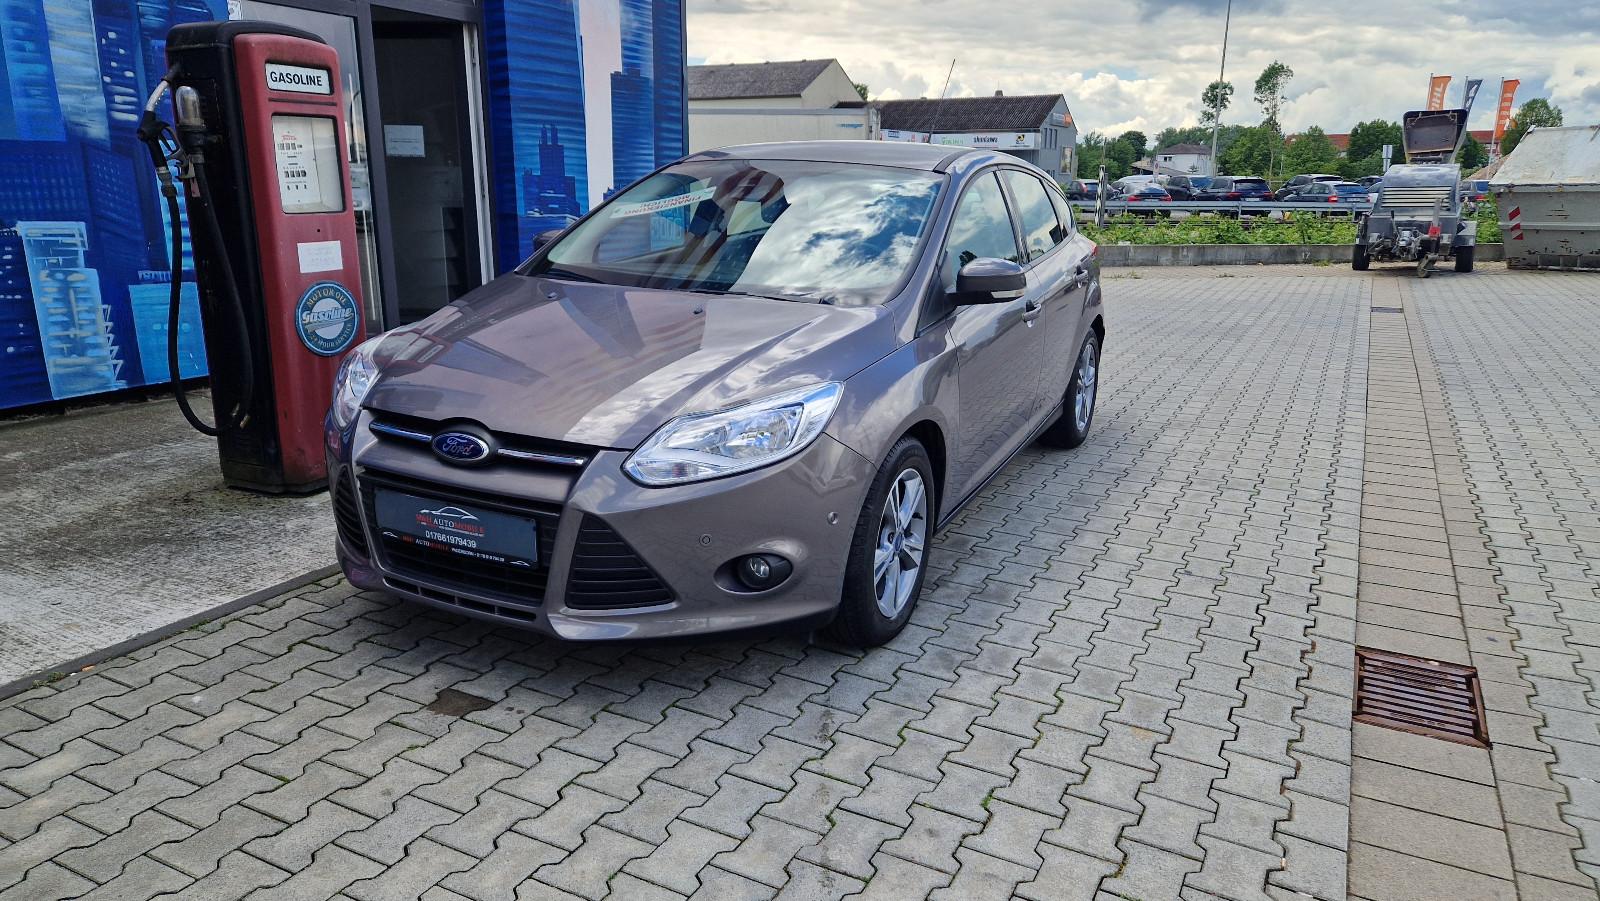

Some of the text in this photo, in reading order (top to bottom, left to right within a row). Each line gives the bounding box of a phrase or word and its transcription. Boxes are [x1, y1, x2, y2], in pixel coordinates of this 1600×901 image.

[270, 71, 323, 86] GASOLINE
[306, 288, 347, 307] MOTOR OIL
[302, 307, 352, 324] Gasoline
[442, 436, 474, 456] Ford
[425, 530, 477, 548] 017661979439
